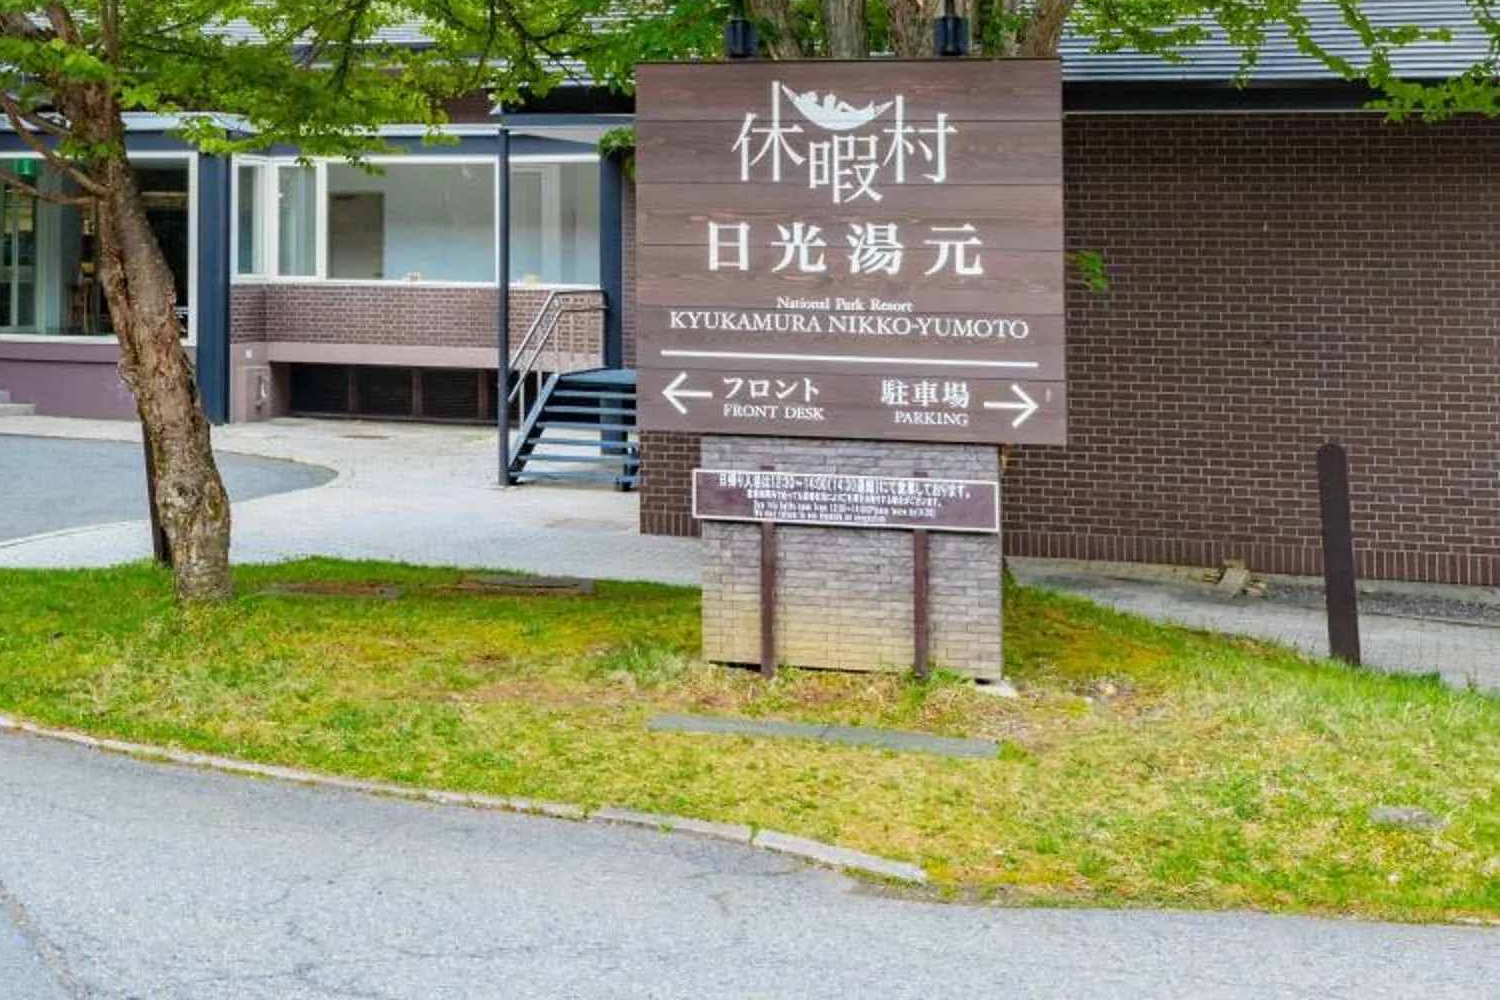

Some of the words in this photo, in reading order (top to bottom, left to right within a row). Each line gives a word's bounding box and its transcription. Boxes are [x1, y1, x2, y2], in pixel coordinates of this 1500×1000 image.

[731, 80, 958, 204] 休暇村
[707, 221, 984, 276] 日光湯元
[777, 295, 830, 310] National
[835, 296, 865, 311] Park
[869, 297, 914, 313] Resort
[669, 311, 823, 333] KYUKAMURA
[828, 315, 1030, 339] NIKKO-YUMOTO
[723, 377, 820, 402] フロント
[880, 379, 970, 409] 駐車場
[723, 403, 779, 419] FRONT
[784, 406, 825, 421] DESK
[894, 411, 969, 427] PARKING
